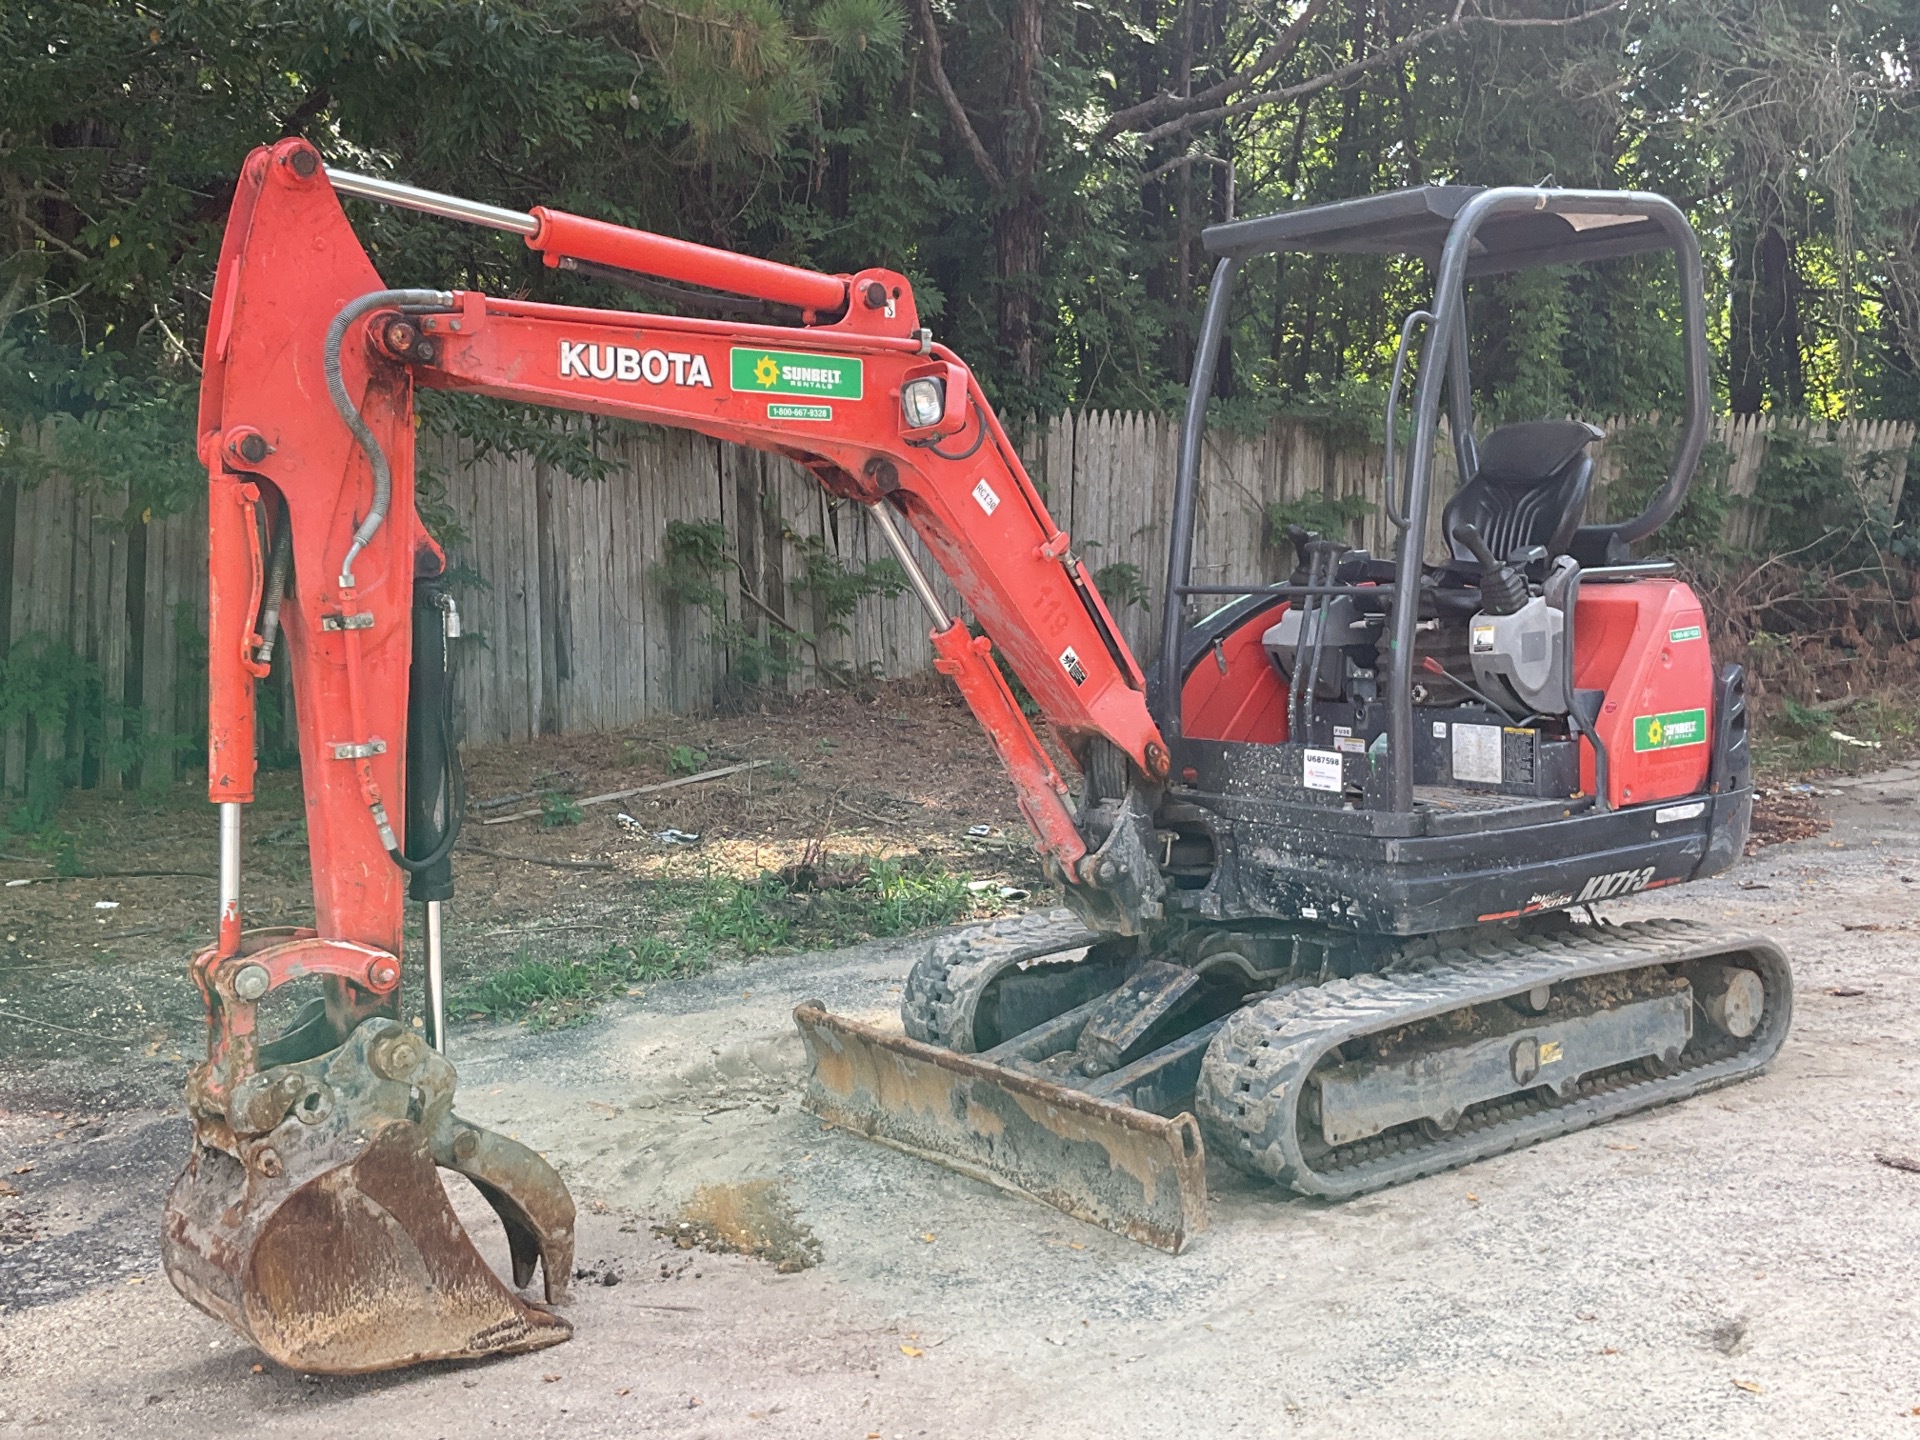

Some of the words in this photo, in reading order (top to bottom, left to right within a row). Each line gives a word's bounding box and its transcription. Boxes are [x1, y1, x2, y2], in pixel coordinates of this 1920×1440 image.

[560, 340, 713, 388] KUBOTA
[782, 366, 841, 384] SUNBELT
[790, 380, 833, 389] RENTALS
[1307, 755, 1340, 766] U687598
[1575, 866, 1656, 902] KX71-3
